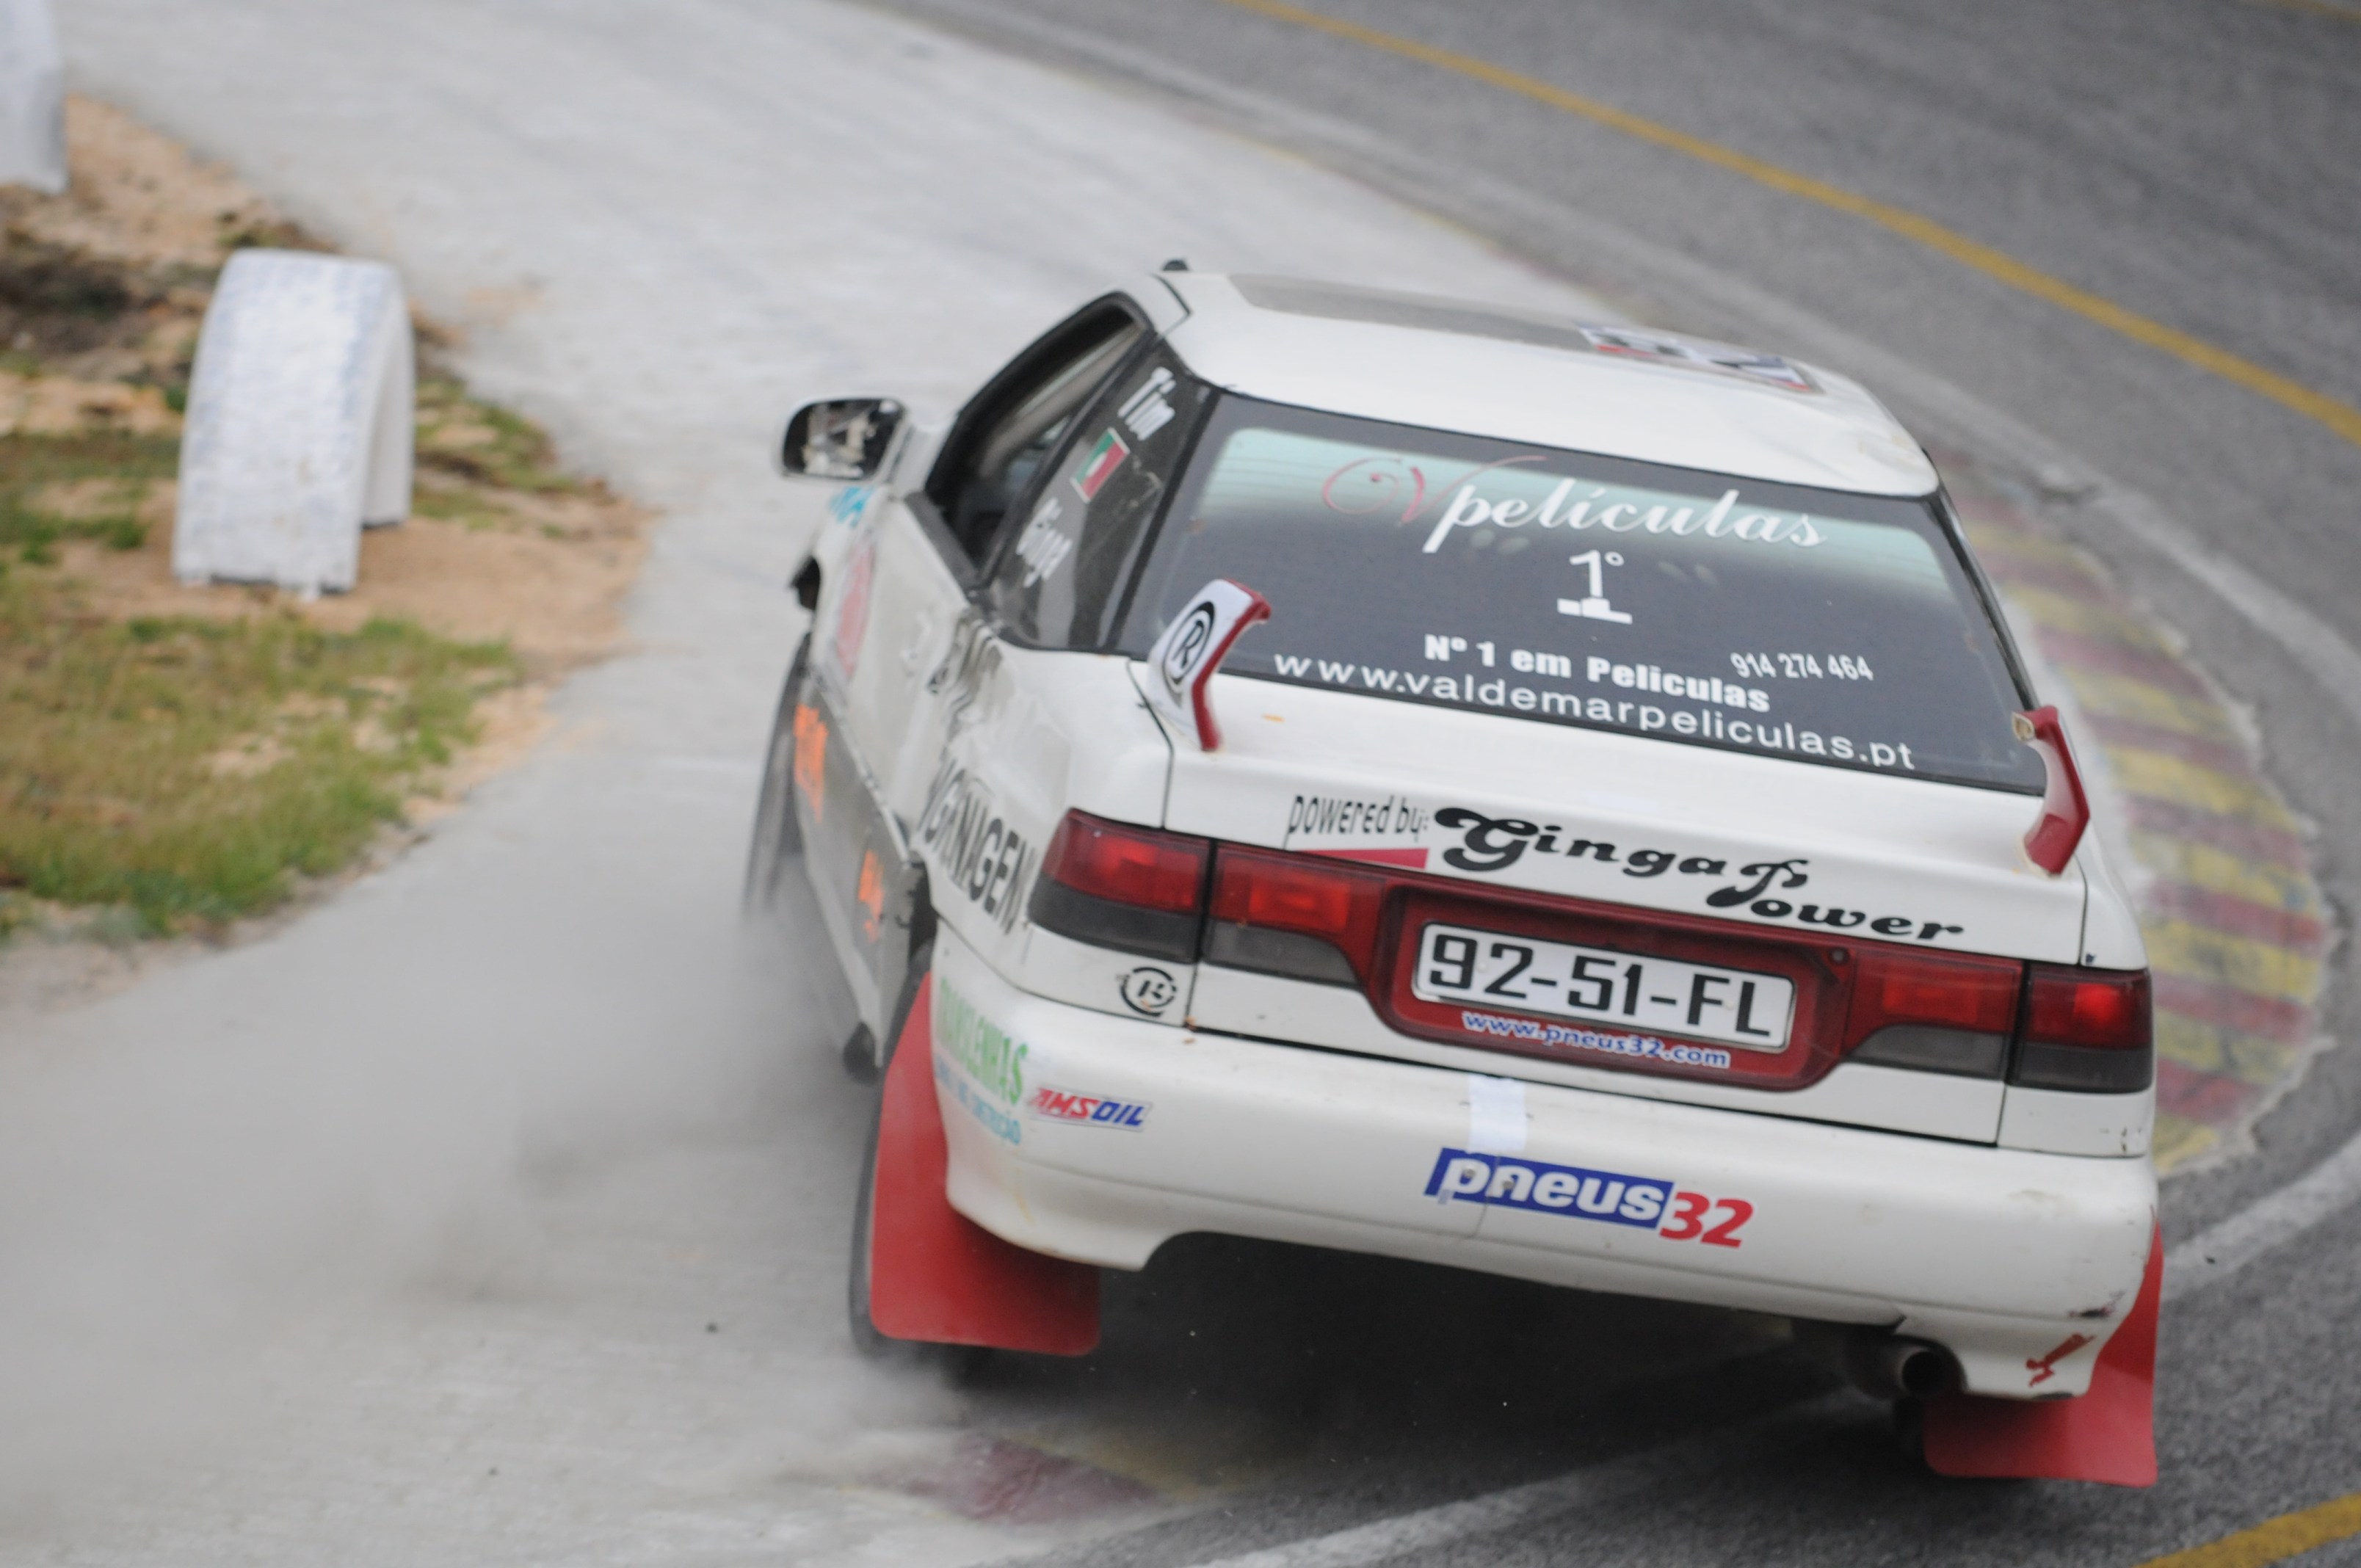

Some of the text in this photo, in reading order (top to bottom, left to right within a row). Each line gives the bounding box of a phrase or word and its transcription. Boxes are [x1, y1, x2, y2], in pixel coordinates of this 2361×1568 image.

[1477, 641, 1495, 667] 1
[1510, 649, 1573, 679] em
[1586, 656, 1771, 713] Peliculas
[1730, 652, 1874, 681] 914 274 464
[1274, 653, 1915, 770] www.valdemarpeliculas.pt
[1283, 794, 1393, 851] powered
[1434, 807, 1965, 940] Ginga Power
[1429, 934, 1771, 1037] 92-51-FL
[1464, 1011, 1730, 1068] www.pneus32.com
[1029, 1086, 1146, 1127] AMSOIL
